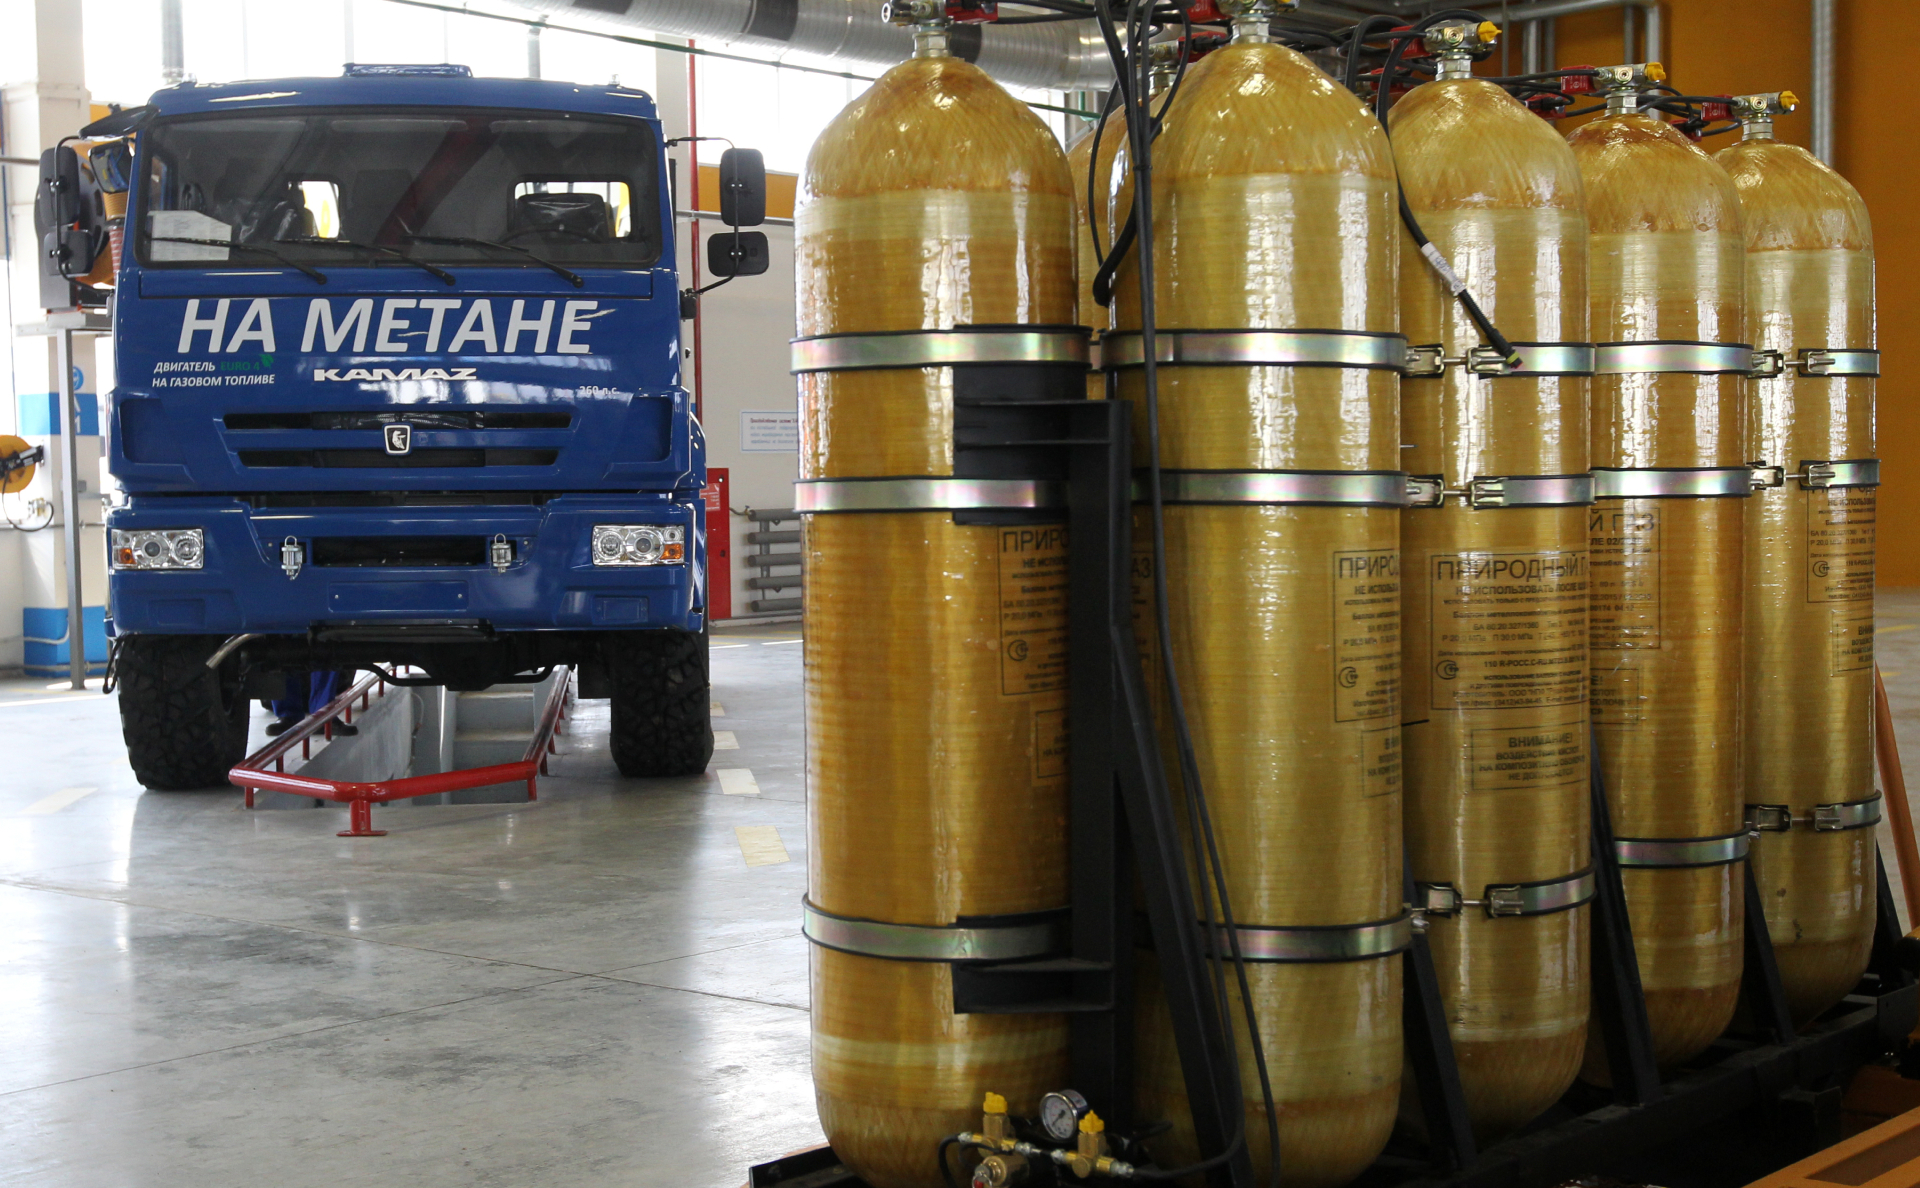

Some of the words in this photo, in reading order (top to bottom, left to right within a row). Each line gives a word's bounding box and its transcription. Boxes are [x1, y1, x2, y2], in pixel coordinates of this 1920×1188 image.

[177, 299, 276, 354] НА
[301, 299, 599, 354] МЕТАНЕ
[154, 362, 216, 374] ДВИГАТЕЛЬ
[221, 361, 251, 371] EURO
[253, 361, 260, 371] 4
[152, 378, 167, 388] НА
[170, 376, 222, 387] ГАЗОВОМ
[225, 374, 276, 386] ТОПЛИВЕ
[314, 368, 478, 382] KAMAZ
[579, 386, 599, 395] 260
[1438, 553, 1579, 582] ПРИРОДНЫЙ
[1456, 586, 1470, 595] НЕ
[1474, 584, 1554, 595] ИСПОЛЬЗОВАТЬ
[1509, 732, 1573, 747] ВНИМАНИЕ!
